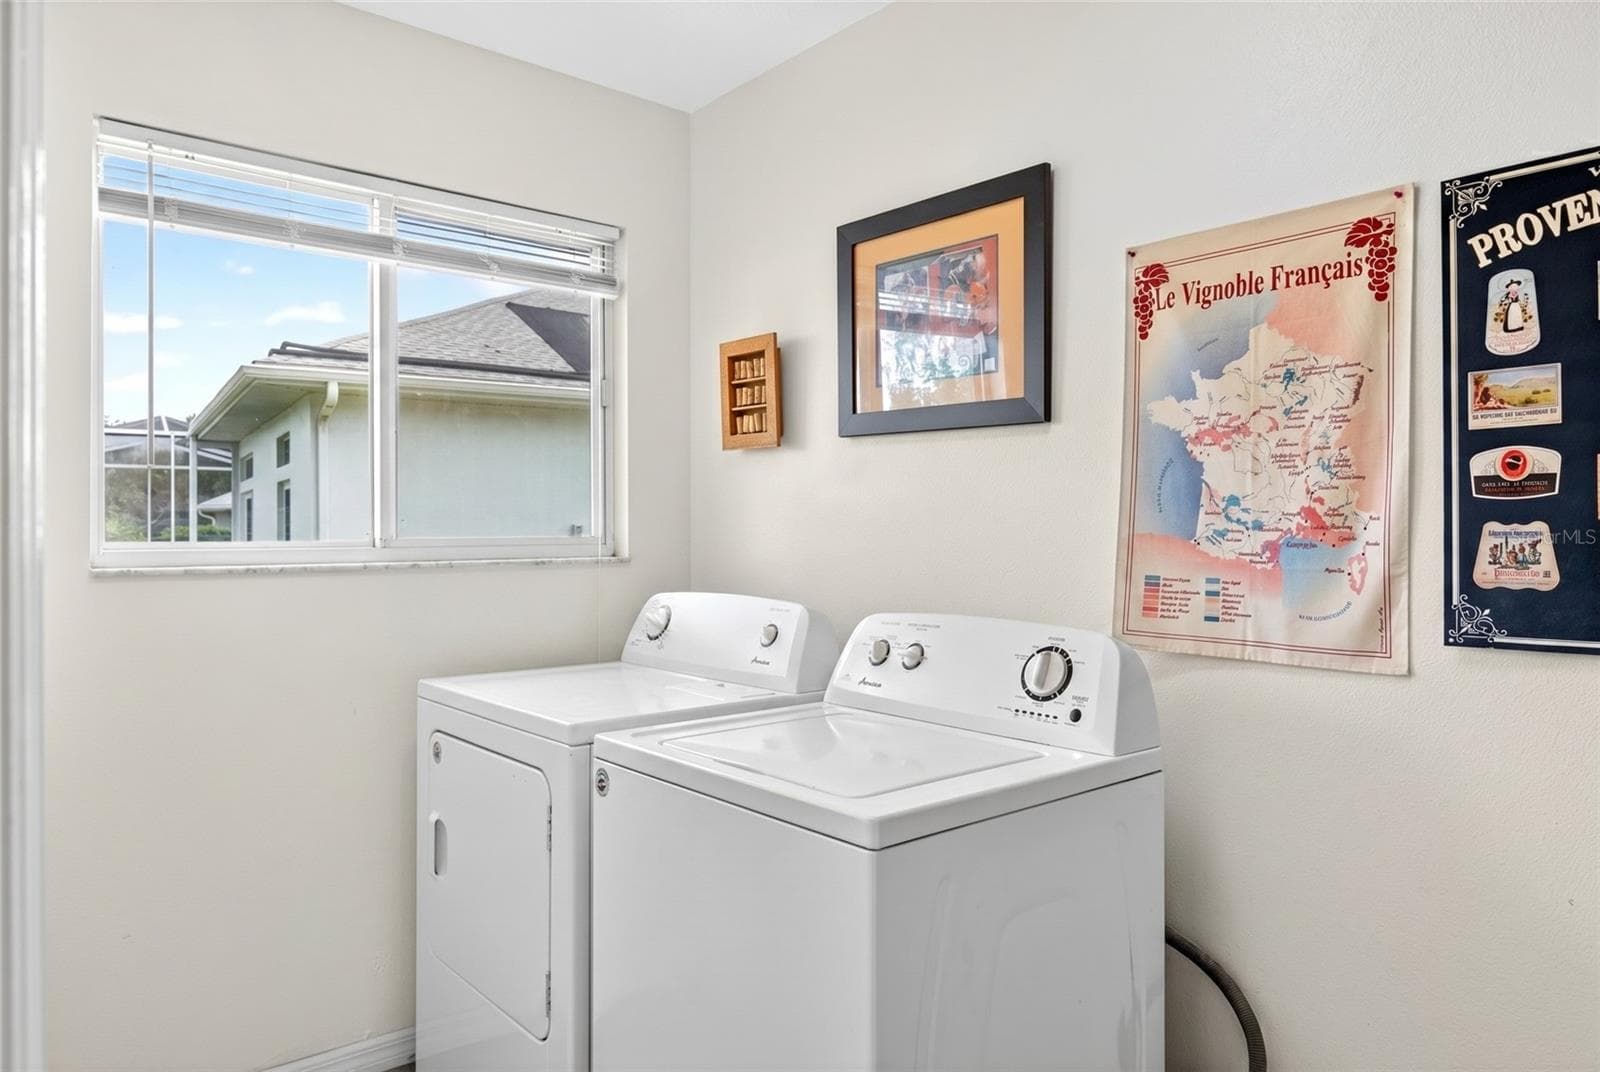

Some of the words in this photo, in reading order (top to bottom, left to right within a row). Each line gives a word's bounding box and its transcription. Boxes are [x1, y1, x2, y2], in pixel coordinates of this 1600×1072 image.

[1155, 287, 1176, 312] Le
[1181, 271, 1265, 310] Vignoble
[1270, 252, 1363, 292] Français
